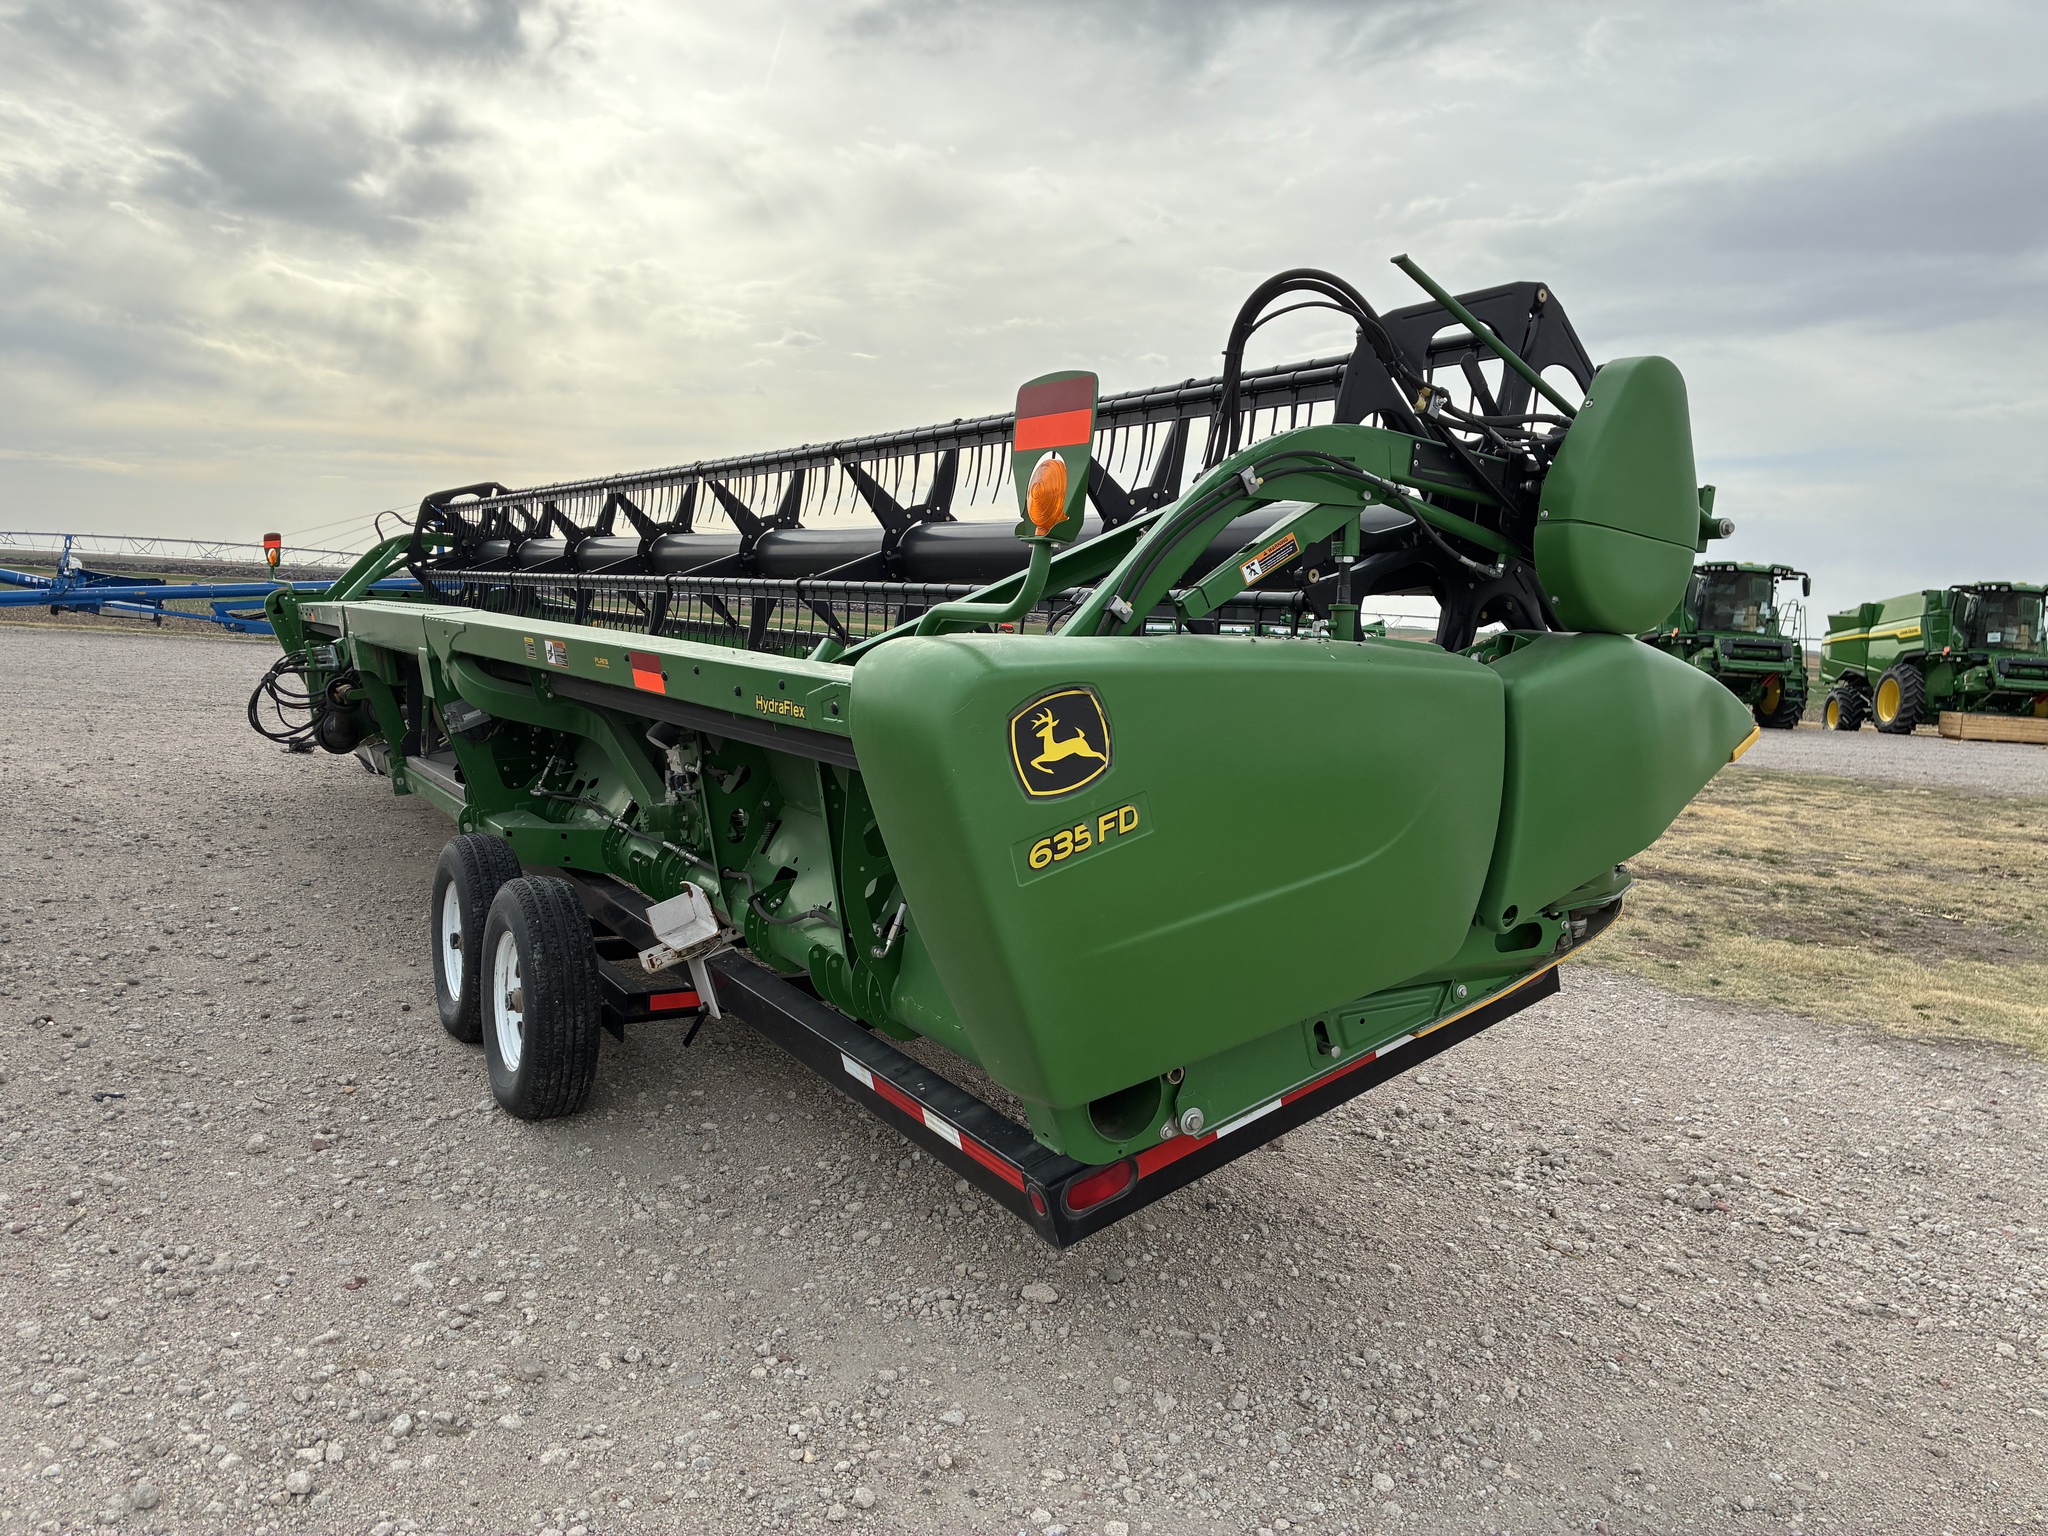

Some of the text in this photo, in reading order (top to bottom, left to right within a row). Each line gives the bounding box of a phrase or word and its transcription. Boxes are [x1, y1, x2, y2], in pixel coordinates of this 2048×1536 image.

[755, 694, 806, 719] HydraFlex
[1028, 804, 1140, 870] 635 FD
